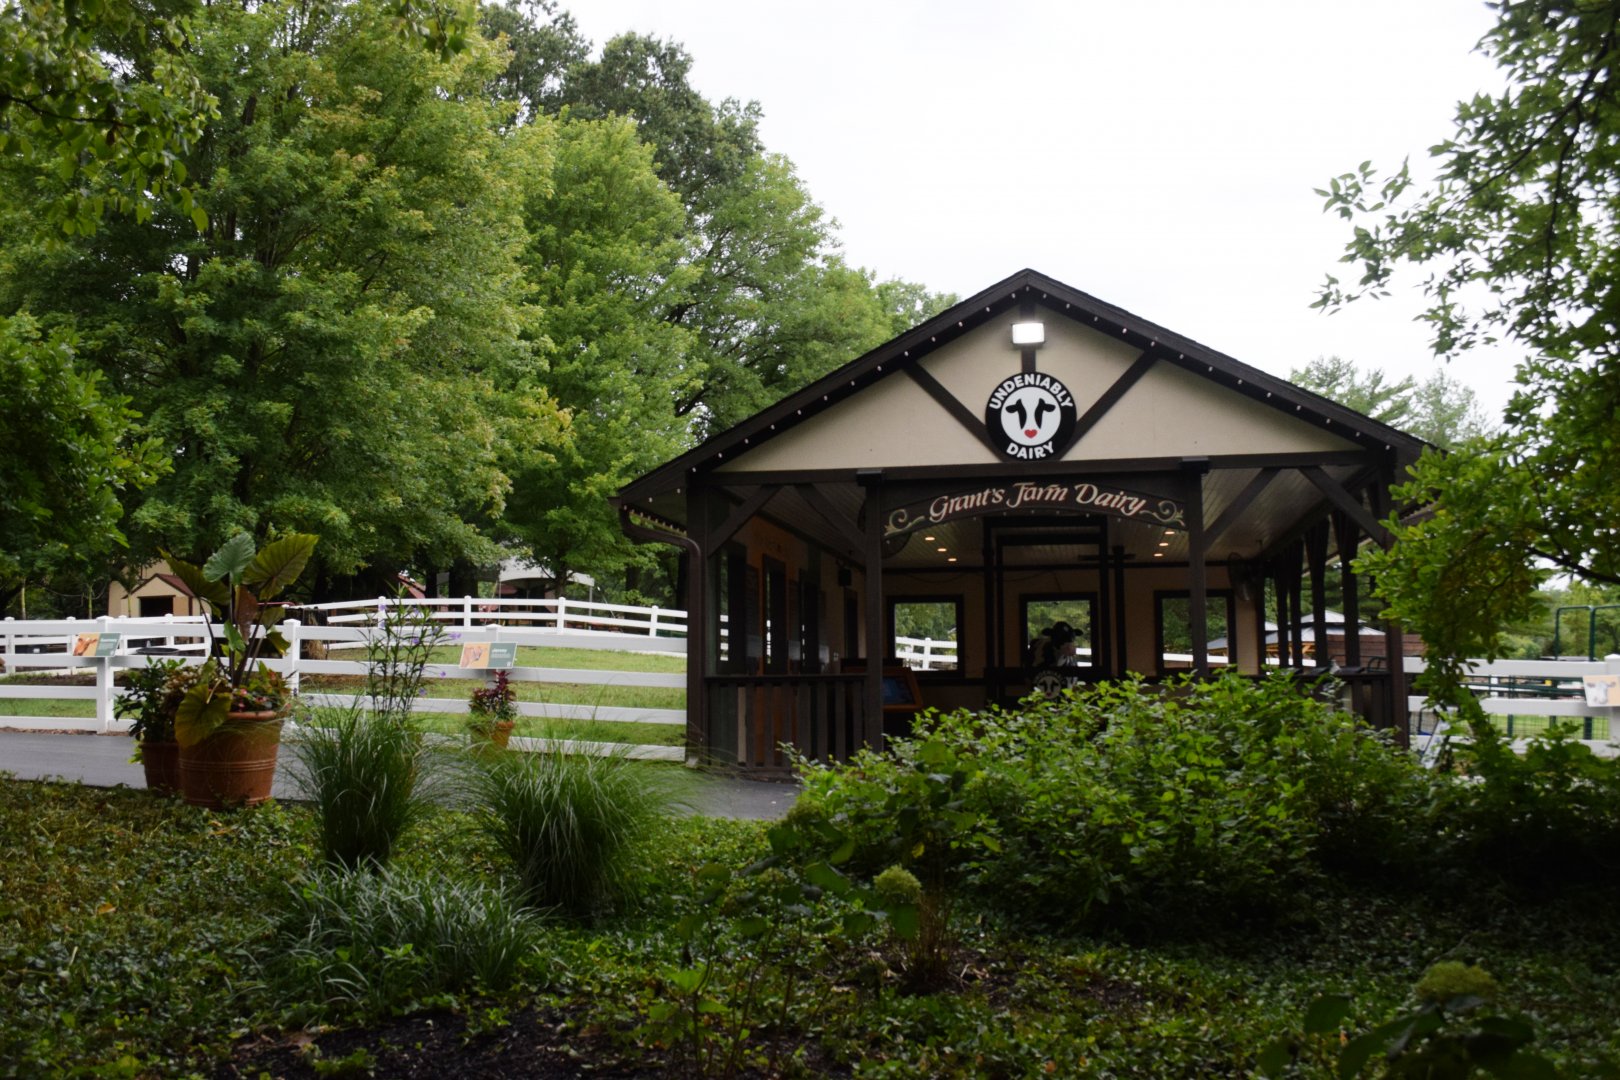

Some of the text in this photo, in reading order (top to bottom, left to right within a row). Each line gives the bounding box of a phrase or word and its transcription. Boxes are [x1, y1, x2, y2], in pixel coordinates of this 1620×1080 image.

[989, 373, 1074, 410] UNDENIABLY
[1006, 441, 1055, 459] DAIRY
[929, 481, 1147, 522] Grant's Farm Dairy
